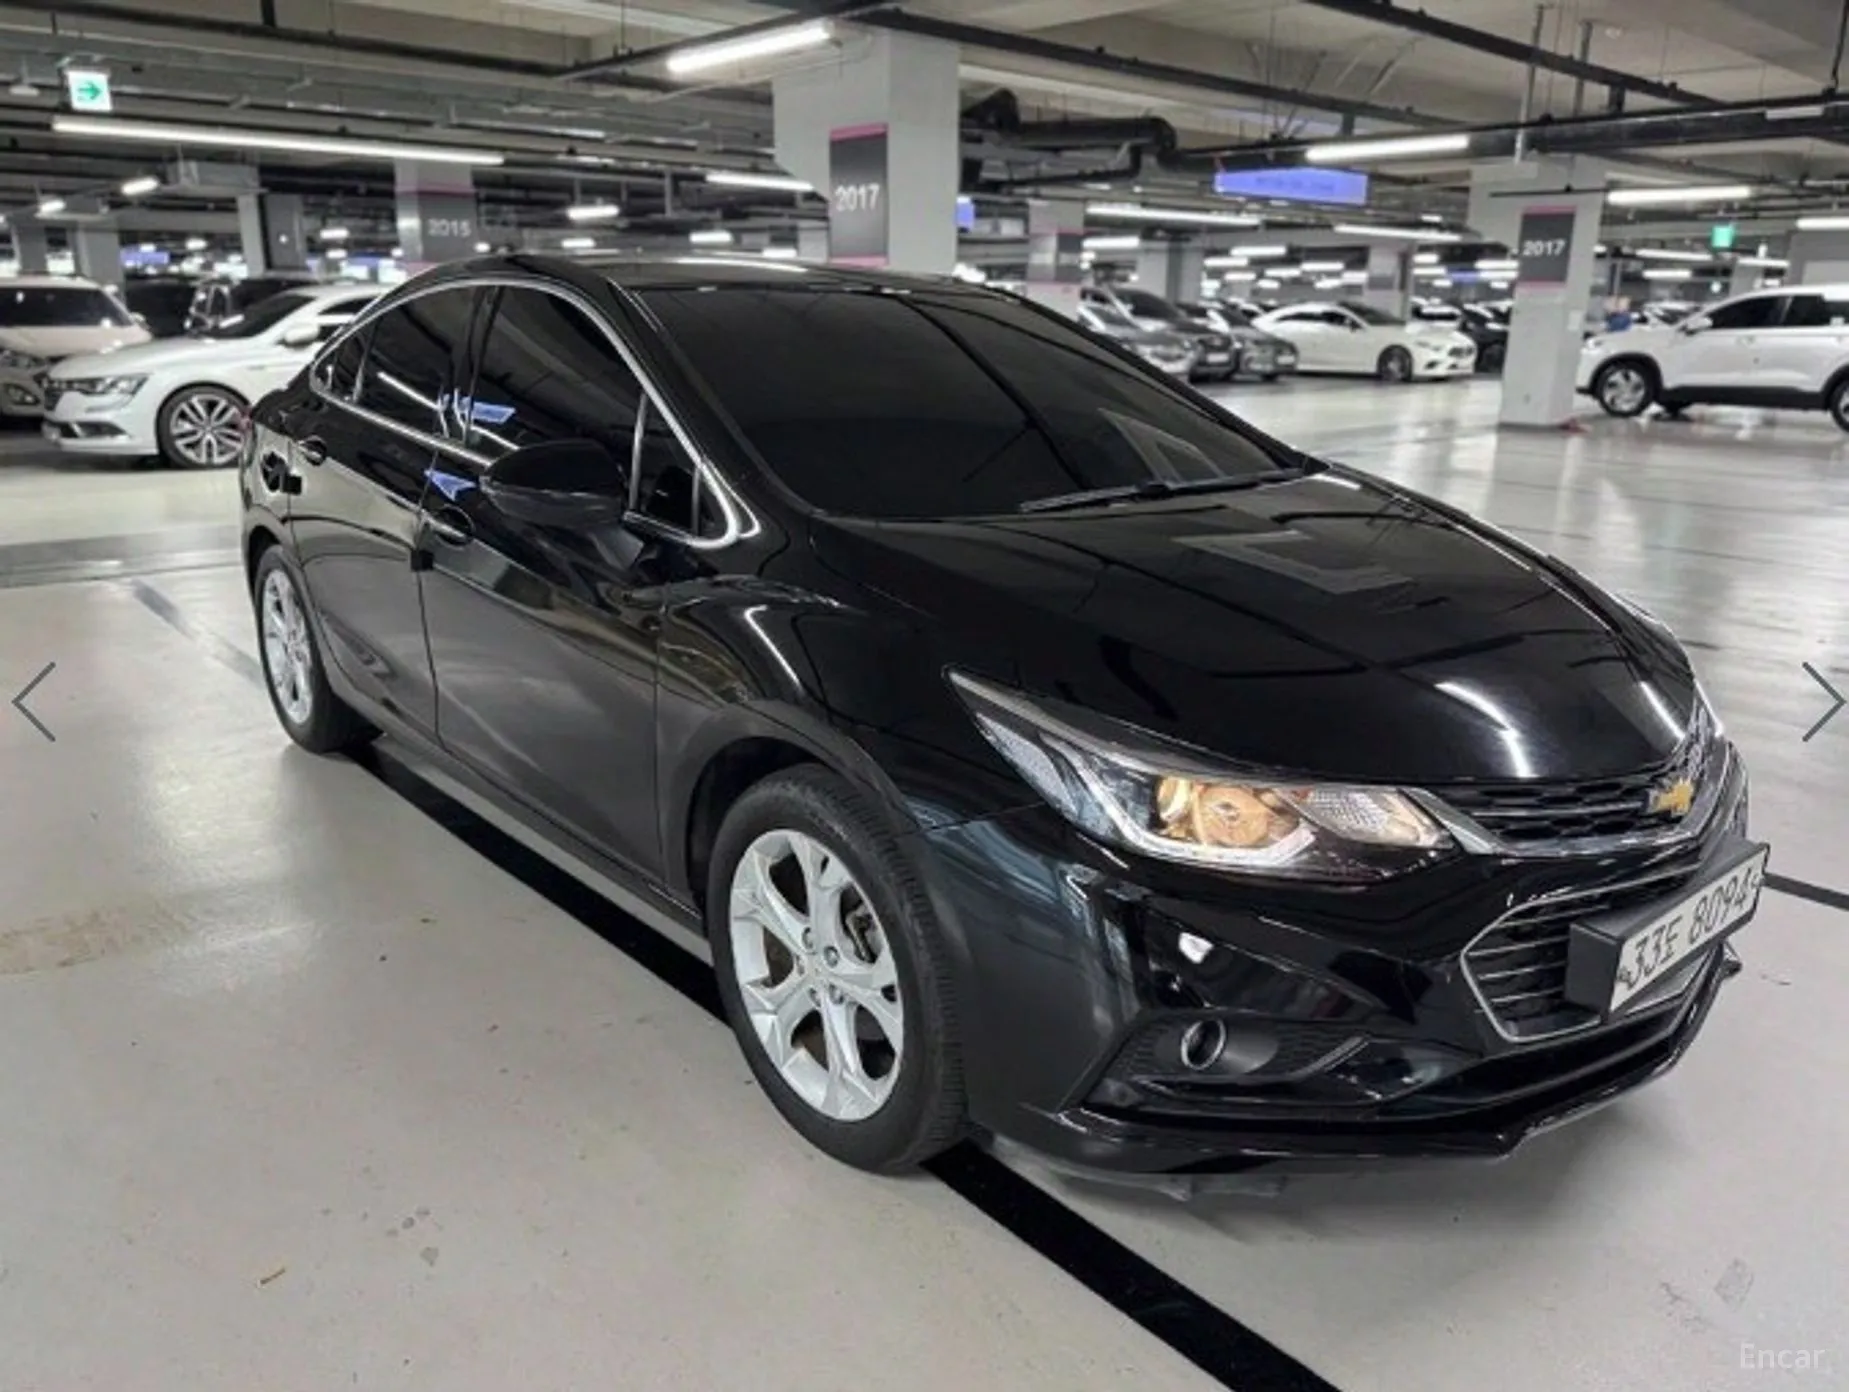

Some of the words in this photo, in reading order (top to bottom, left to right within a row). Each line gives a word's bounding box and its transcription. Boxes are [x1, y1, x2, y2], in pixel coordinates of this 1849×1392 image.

[835, 183, 880, 211] 2017
[428, 218, 472, 237] 2015
[1523, 239, 1566, 256] 2017
[1688, 867, 1752, 945] 8094
